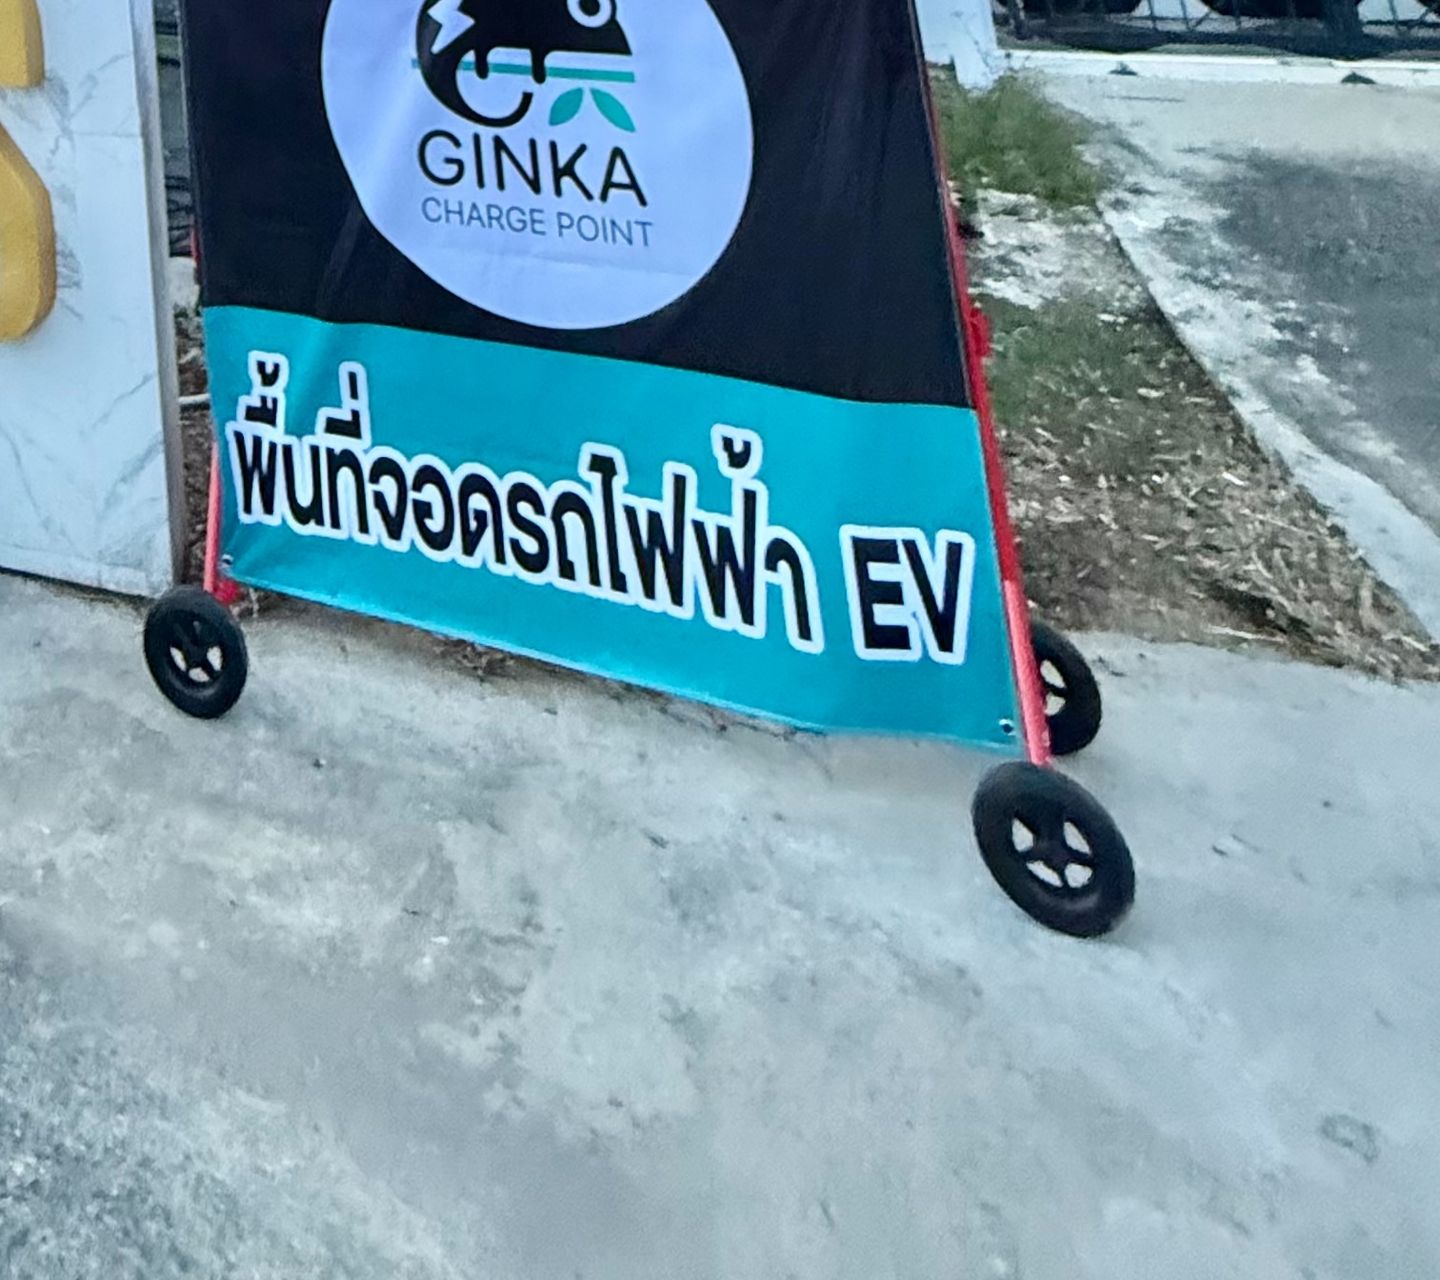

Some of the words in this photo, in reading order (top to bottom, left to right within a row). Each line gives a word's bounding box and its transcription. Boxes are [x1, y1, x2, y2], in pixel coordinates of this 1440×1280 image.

[418, 129, 648, 207] GINKA
[421, 197, 546, 236] CHARGE
[557, 211, 654, 248] POINT
[231, 357, 818, 646] พื้นที่จอดรถไฟฟ้า
[847, 533, 969, 657] EV
